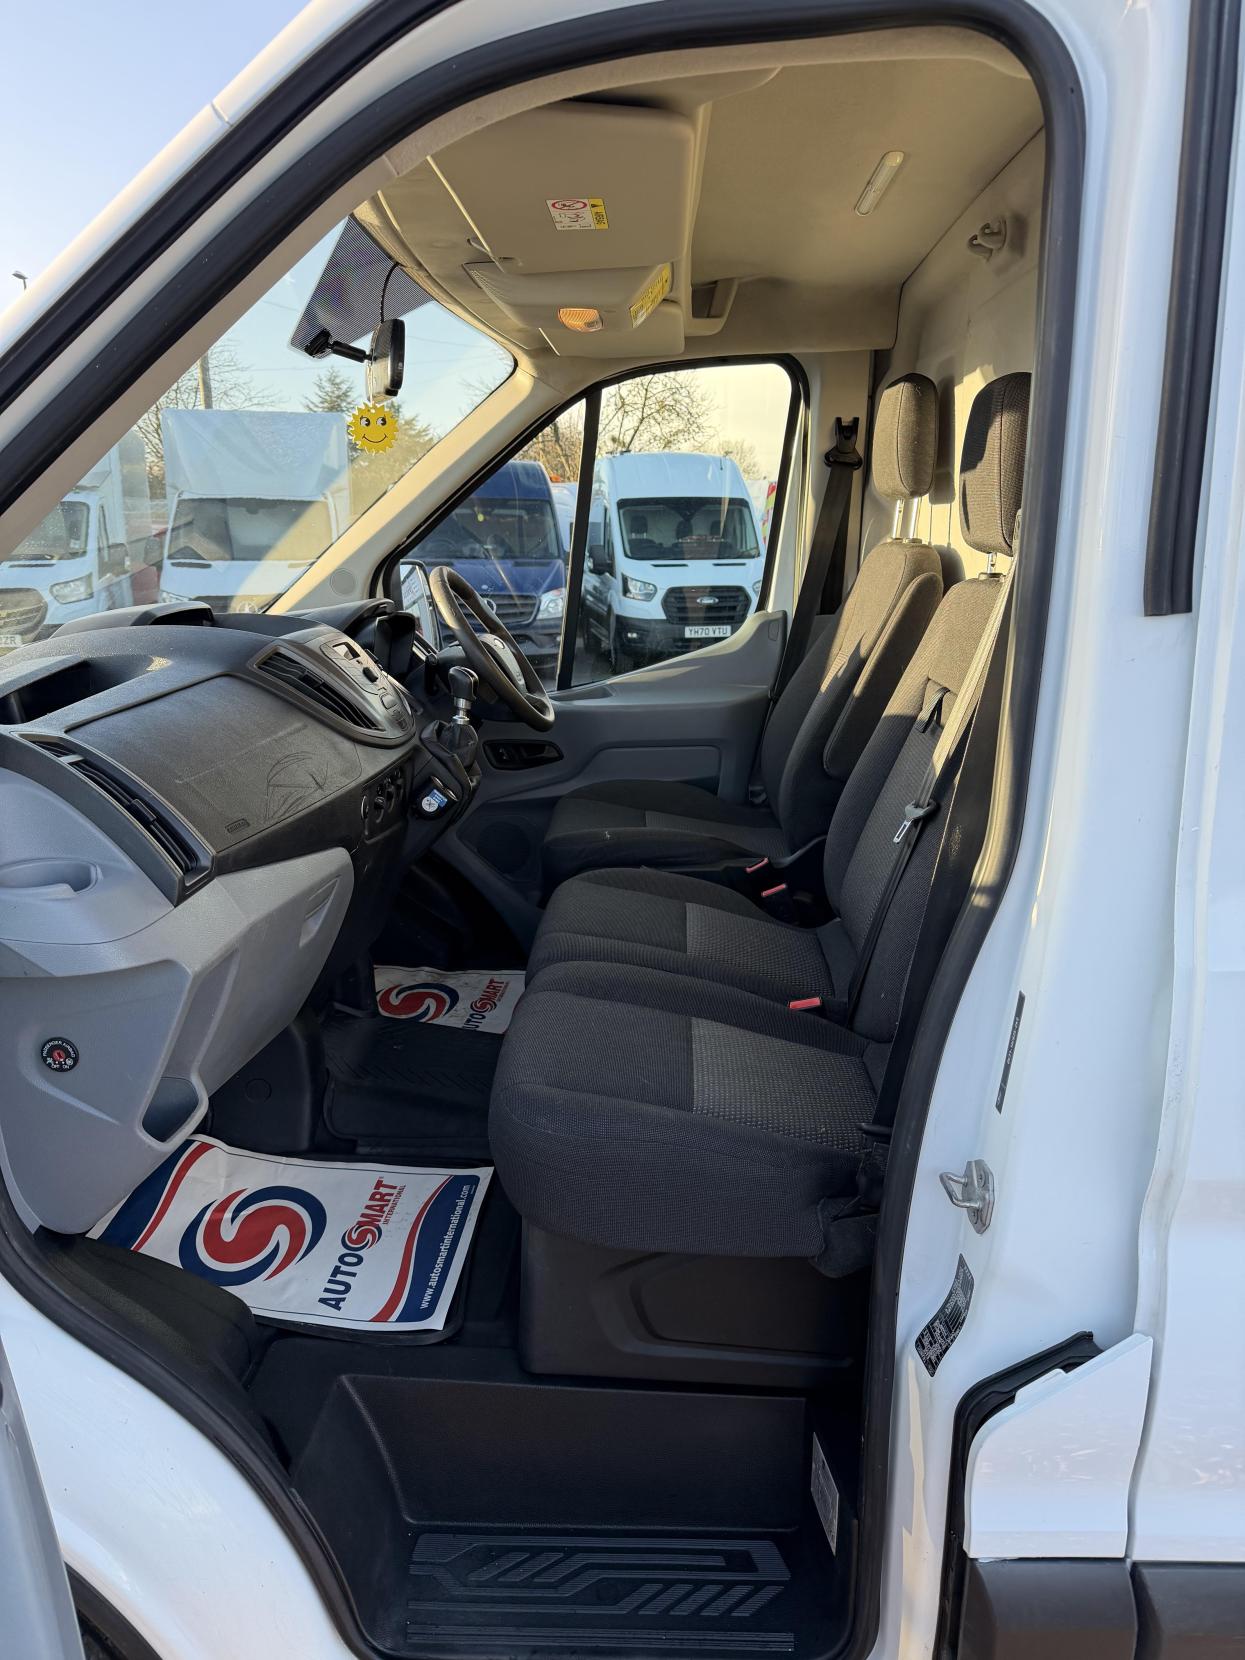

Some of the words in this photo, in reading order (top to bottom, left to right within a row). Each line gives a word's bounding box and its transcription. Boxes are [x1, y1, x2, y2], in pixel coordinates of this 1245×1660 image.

[462, 978, 505, 1031] UTOSMART
[382, 1184, 406, 1225] INTERNATIONAL
[420, 1184, 471, 1310] www.autosmartinternational.com
